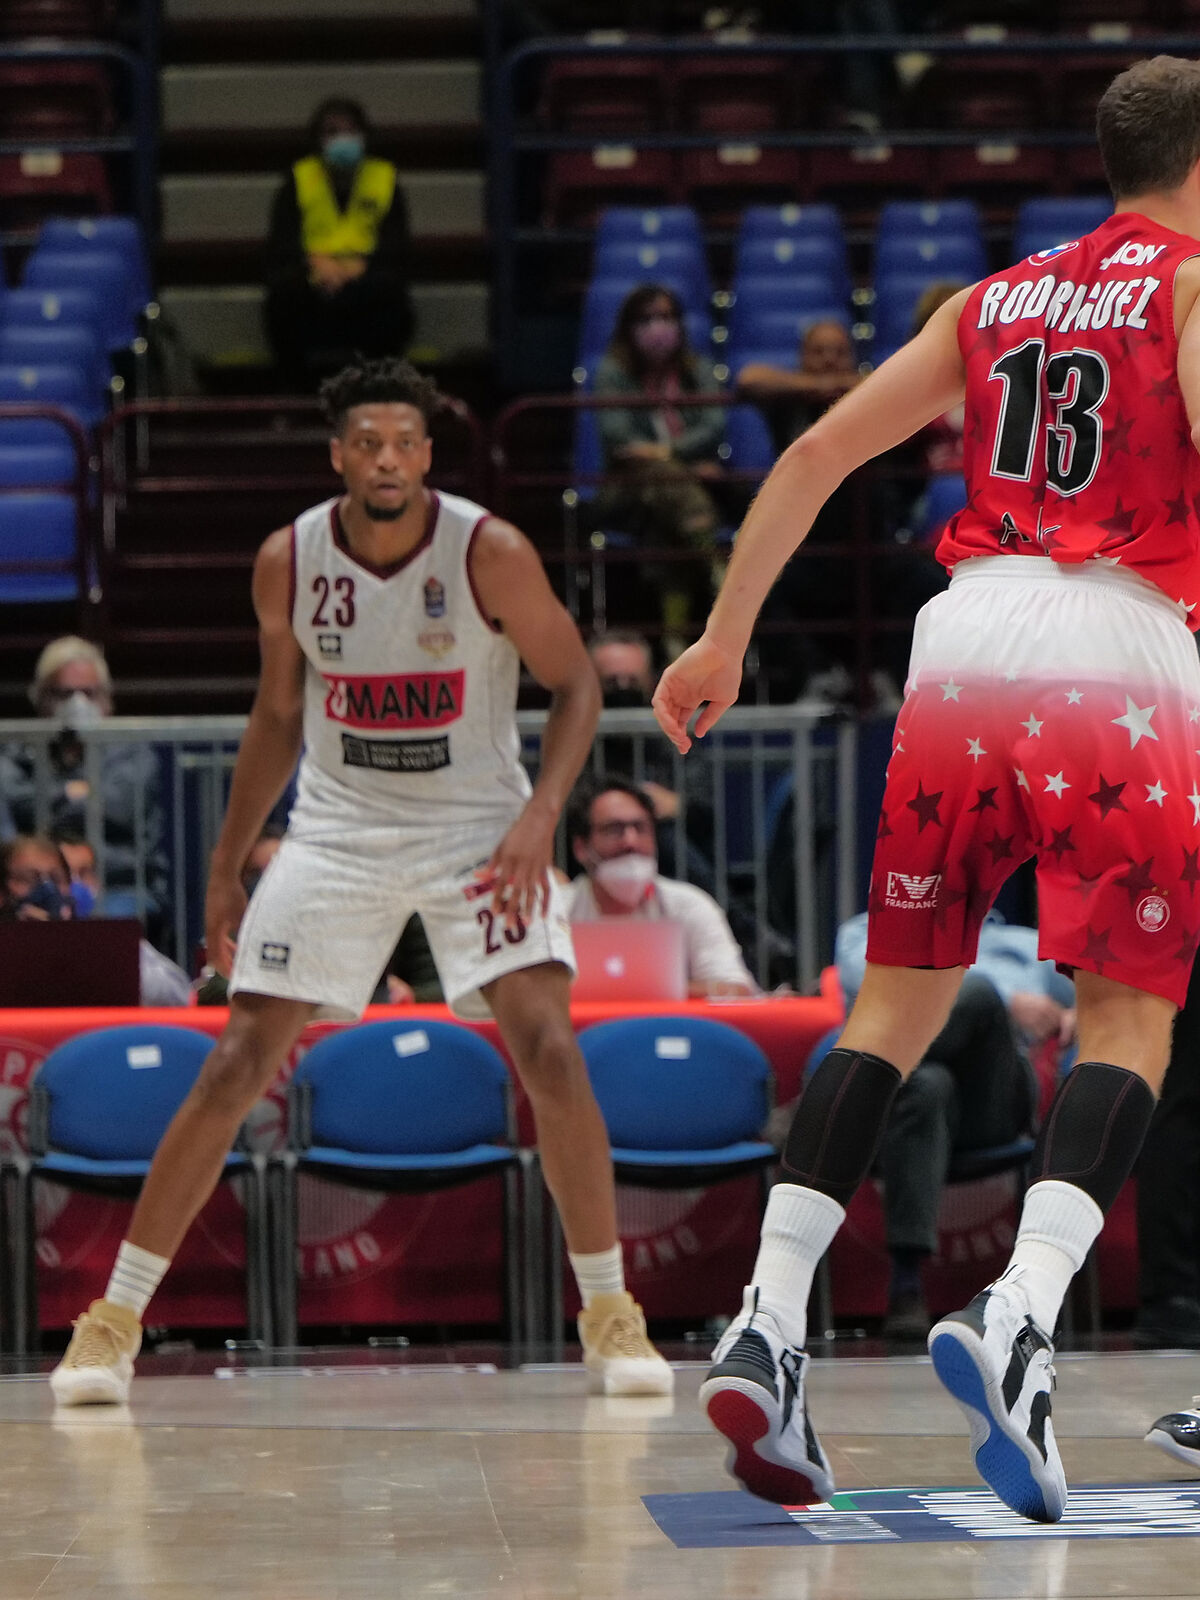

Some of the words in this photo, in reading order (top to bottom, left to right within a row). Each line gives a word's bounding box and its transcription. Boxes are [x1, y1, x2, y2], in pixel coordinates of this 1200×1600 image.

[1099, 240, 1168, 270] AON
[987, 338, 1110, 497] 13
[311, 575, 356, 628] 23
[326, 679, 457, 720] UMANA
[884, 897, 938, 910] FRAGRANC
